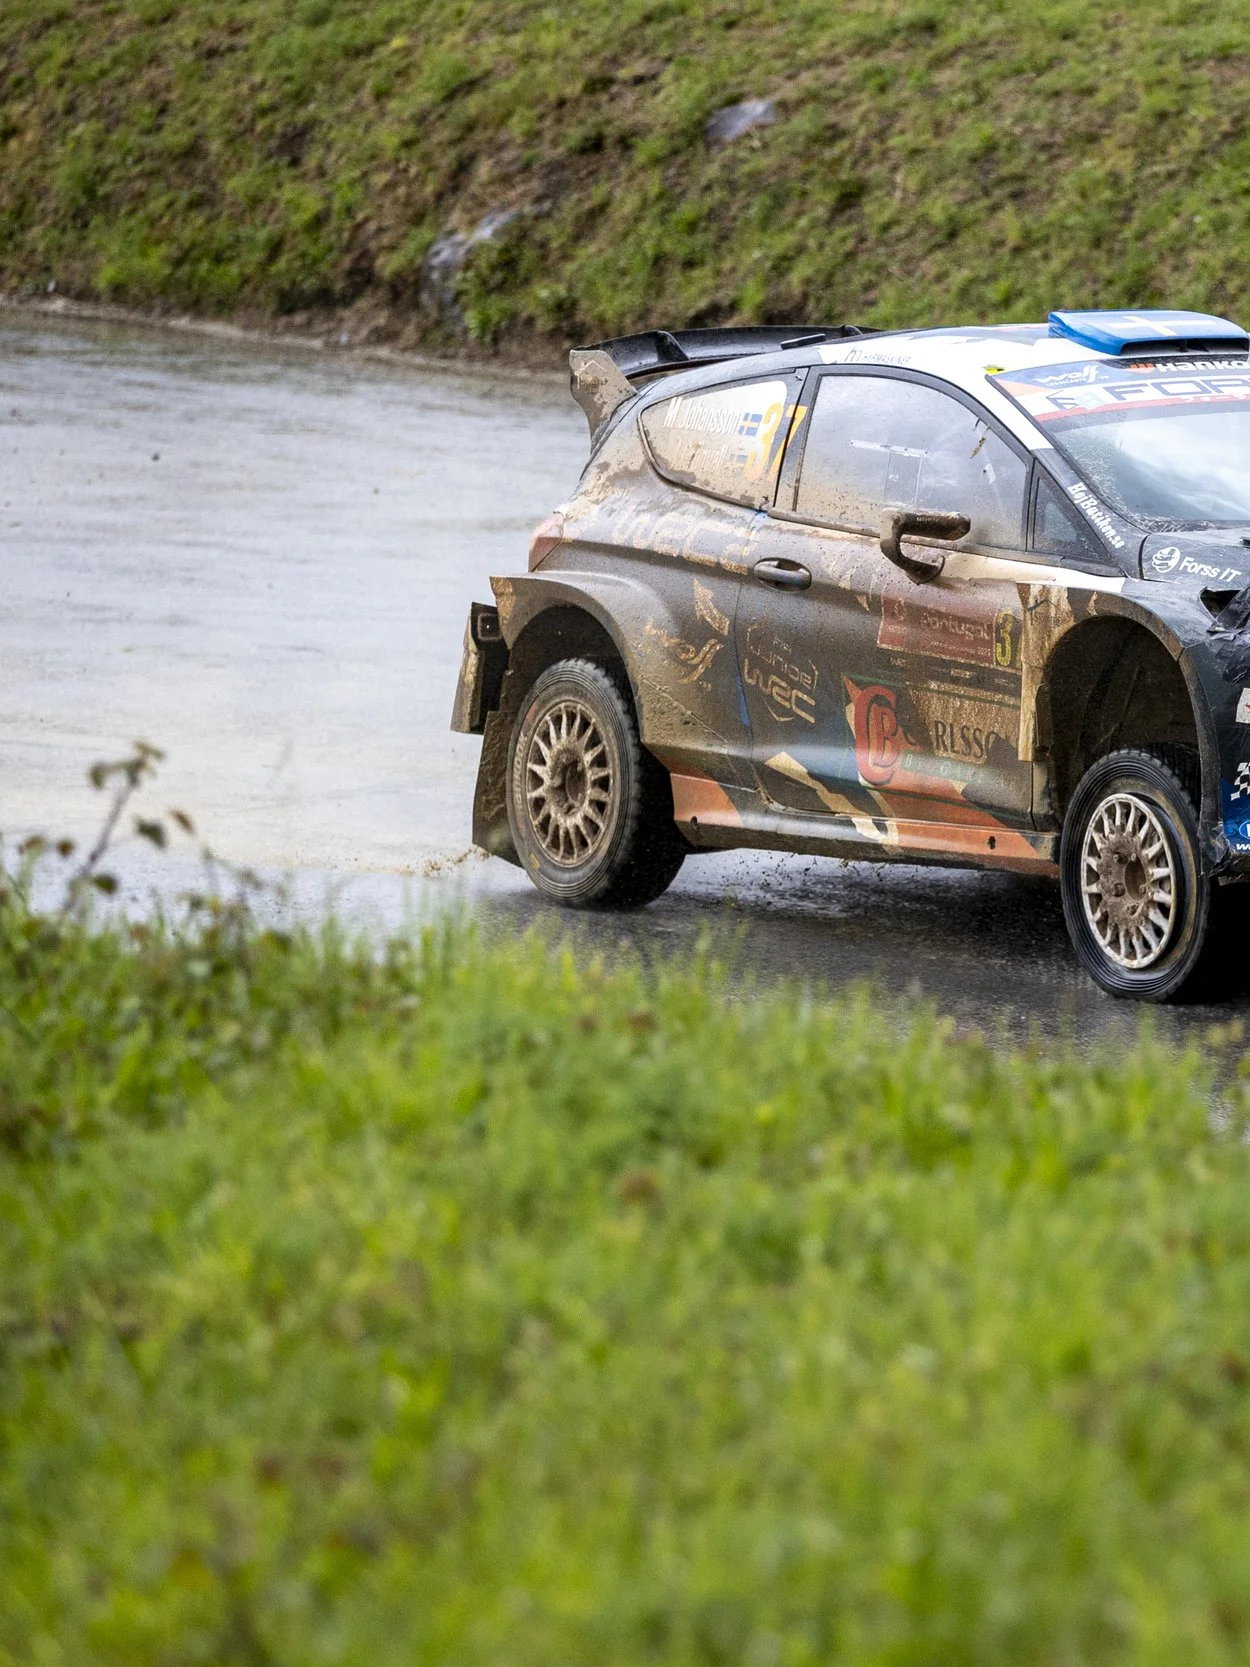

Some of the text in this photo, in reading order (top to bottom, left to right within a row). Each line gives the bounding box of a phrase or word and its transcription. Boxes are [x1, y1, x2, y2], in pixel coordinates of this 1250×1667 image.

[662, 396, 743, 436] M Johansson
[744, 401, 809, 483] 37
[1178, 556, 1242, 583] Forss IT
